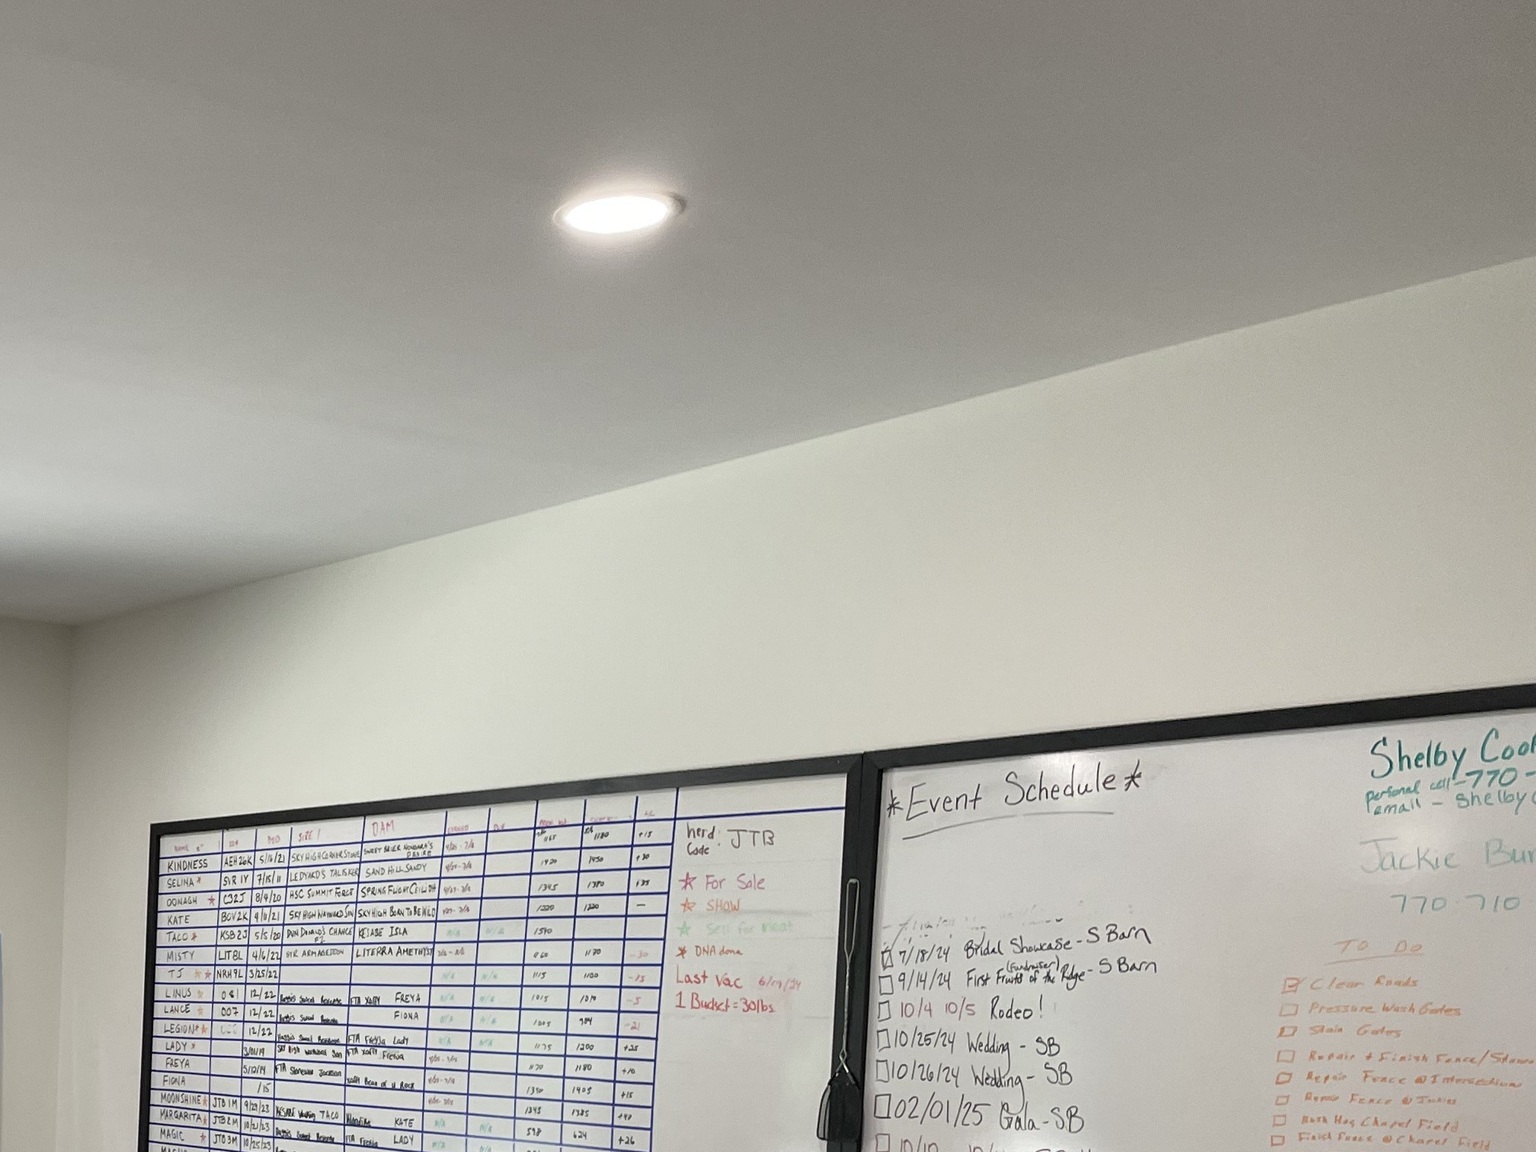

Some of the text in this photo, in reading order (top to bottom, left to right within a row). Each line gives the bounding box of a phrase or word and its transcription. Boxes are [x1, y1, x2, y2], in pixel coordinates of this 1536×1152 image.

[1370, 737, 1467, 780] Shelby
[1465, 767, 1517, 789] 770
[1374, 799, 1420, 815] email
[372, 820, 395, 837] DAM
[727, 829, 775, 849] JTB
[1359, 837, 1458, 873] Jackie
[167, 859, 208, 872] KINDNESS
[167, 878, 194, 889] SELINA
[705, 873, 766, 890] For Sale
[706, 899, 741, 913] SHOW
[1390, 894, 1447, 914] 770
[167, 915, 190, 926] KATE
[166, 931, 188, 942] TACO
[388, 926, 408, 938] ISLA
[695, 945, 716, 957] DNA
[898, 923, 1151, 964] 7/18/24 Bridal Showcase S Barn
[167, 951, 195, 962] MISTY
[249, 967, 278, 981] 3/25/22
[676, 964, 742, 989] Last Vac
[898, 970, 950, 992] 9/14/24
[967, 968, 991, 987] First
[1029, 972, 1040, 983] of
[1099, 958, 1112, 974] S
[1117, 957, 1157, 973] Barn
[165, 988, 421, 1003] LINUS FREYA
[675, 991, 686, 1008] 1
[164, 1004, 191, 1014] LANCE
[221, 1007, 239, 1017] 007
[900, 998, 932, 1018] 10/4
[945, 997, 976, 1021] 10/5
[165, 1041, 188, 1052] LADY
[576, 1043, 594, 1051] 1200
[894, 1026, 956, 1054] 10/25/24
[1036, 1036, 1060, 1056] SB
[166, 1057, 190, 1068] FREYA
[891, 1060, 959, 1088] 10/26/24
[1044, 1061, 1073, 1086] SB
[160, 1092, 415, 1128] MOONSHINE TACO KATE
[893, 1094, 991, 1127] 02/01/25
[160, 1109, 414, 1146] MARGARITA LADY
[160, 1128, 184, 1141] MAGIC
